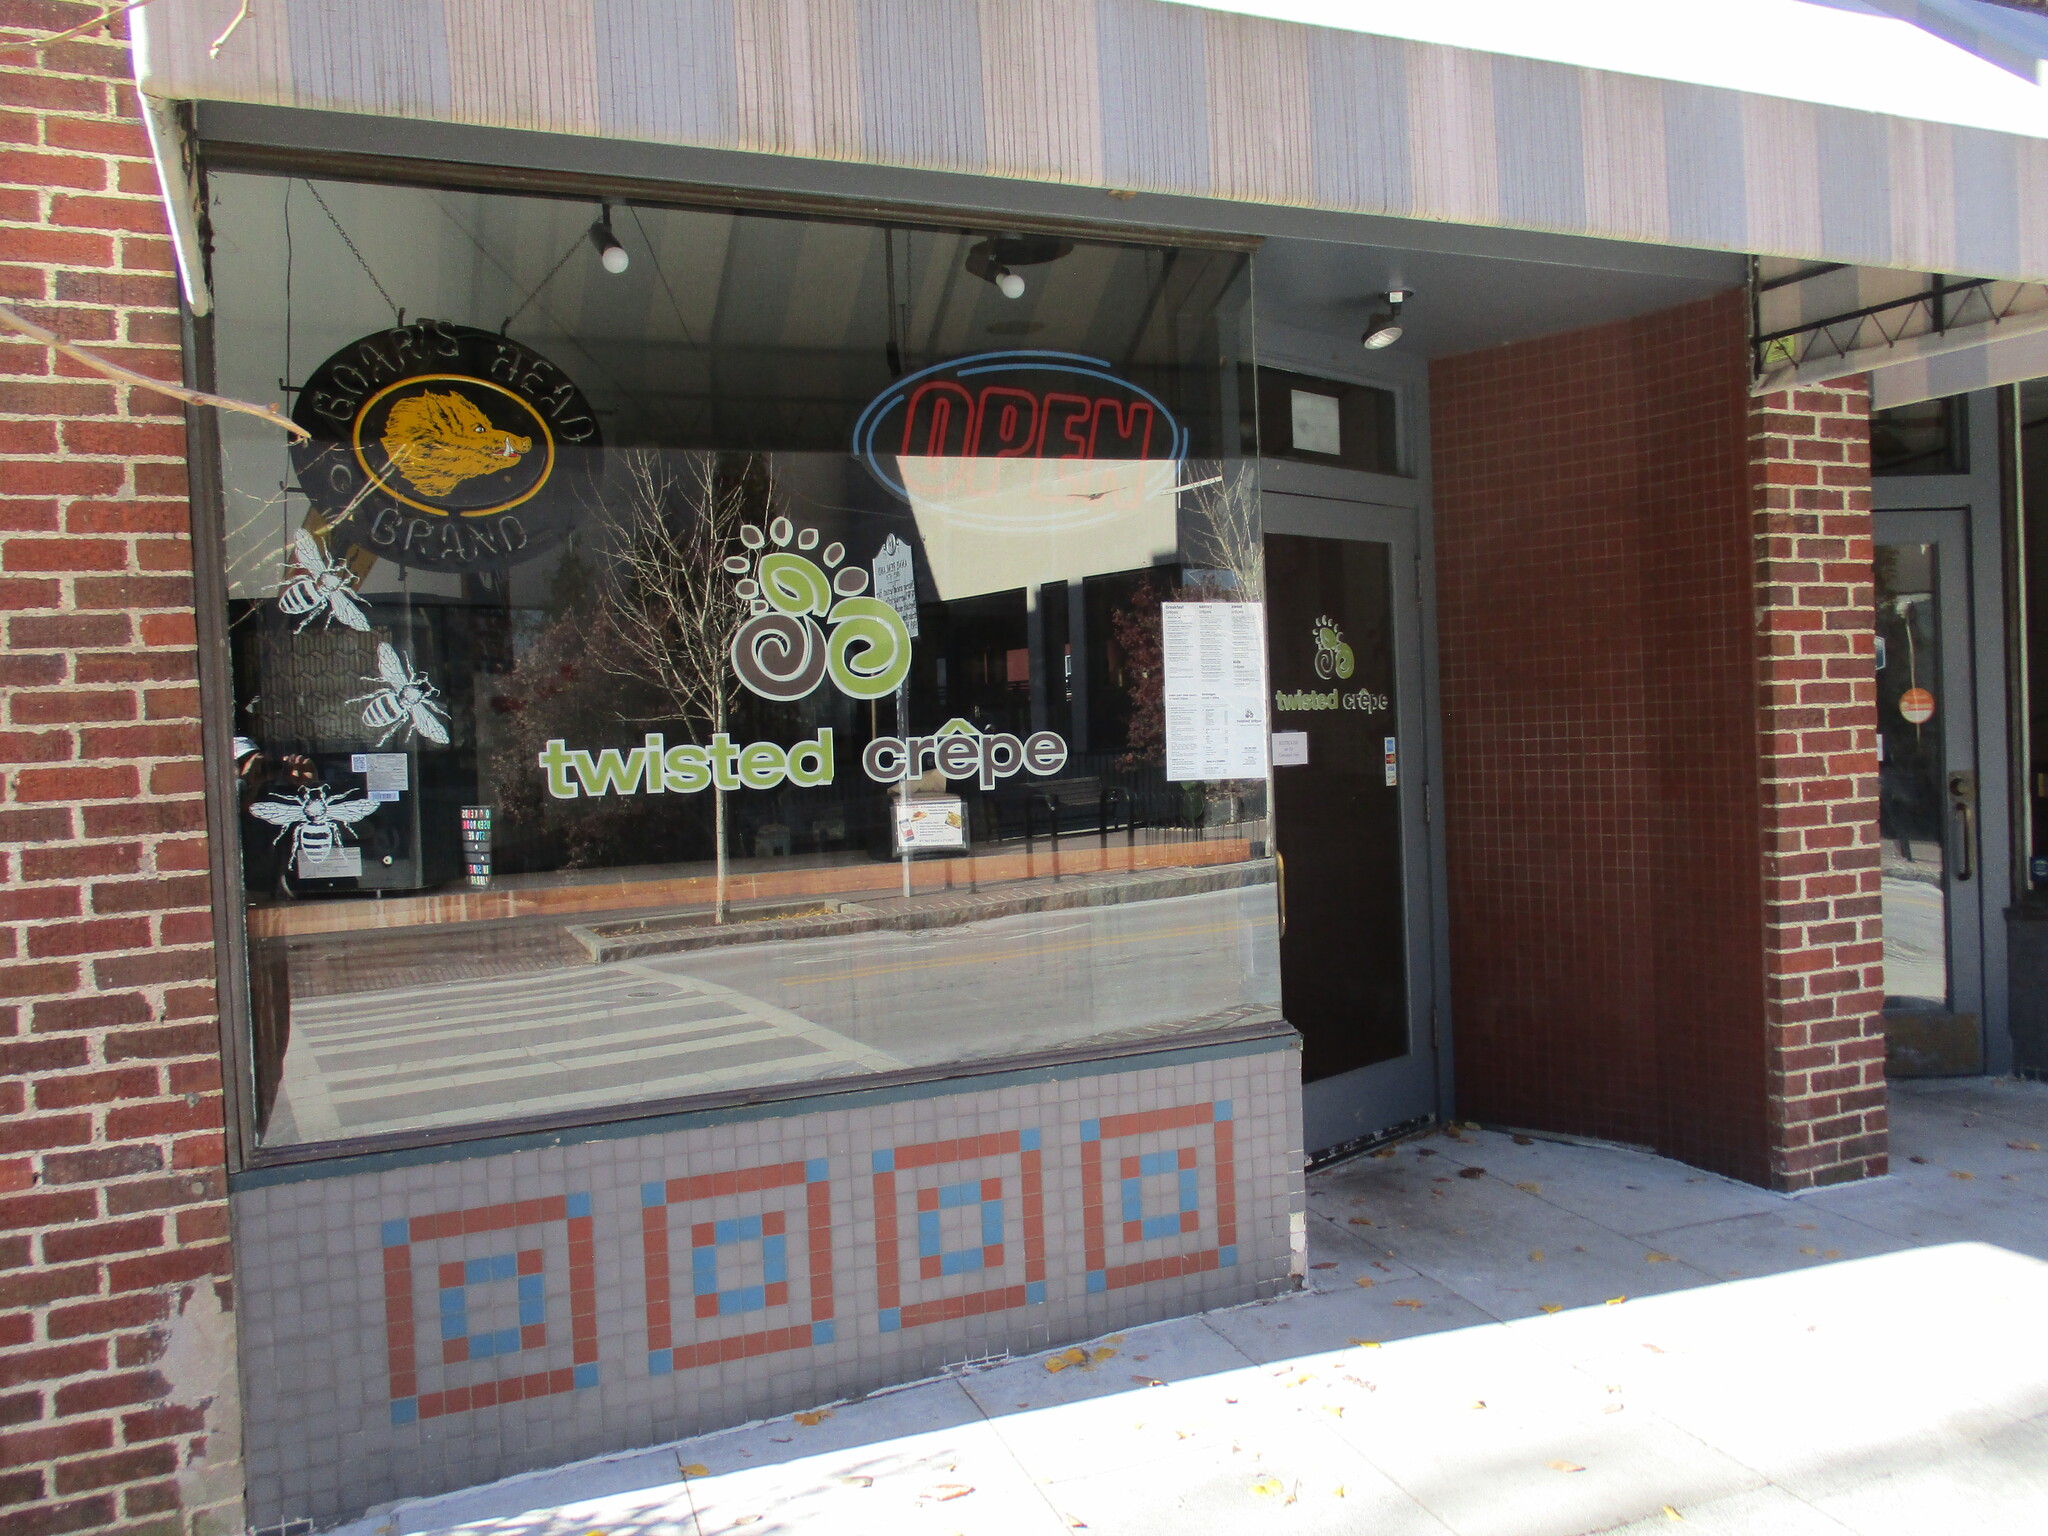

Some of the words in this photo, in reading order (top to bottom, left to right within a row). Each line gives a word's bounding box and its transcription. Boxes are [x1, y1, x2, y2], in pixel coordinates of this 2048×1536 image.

[491, 344, 596, 443] HEAD
[900, 380, 1154, 510] OPEN
[371, 507, 528, 562] BRAND
[1275, 688, 1338, 711] twisted
[1343, 688, 1389, 714] crêpe
[538, 727, 834, 800] twisted
[863, 717, 1067, 792] crêpe
